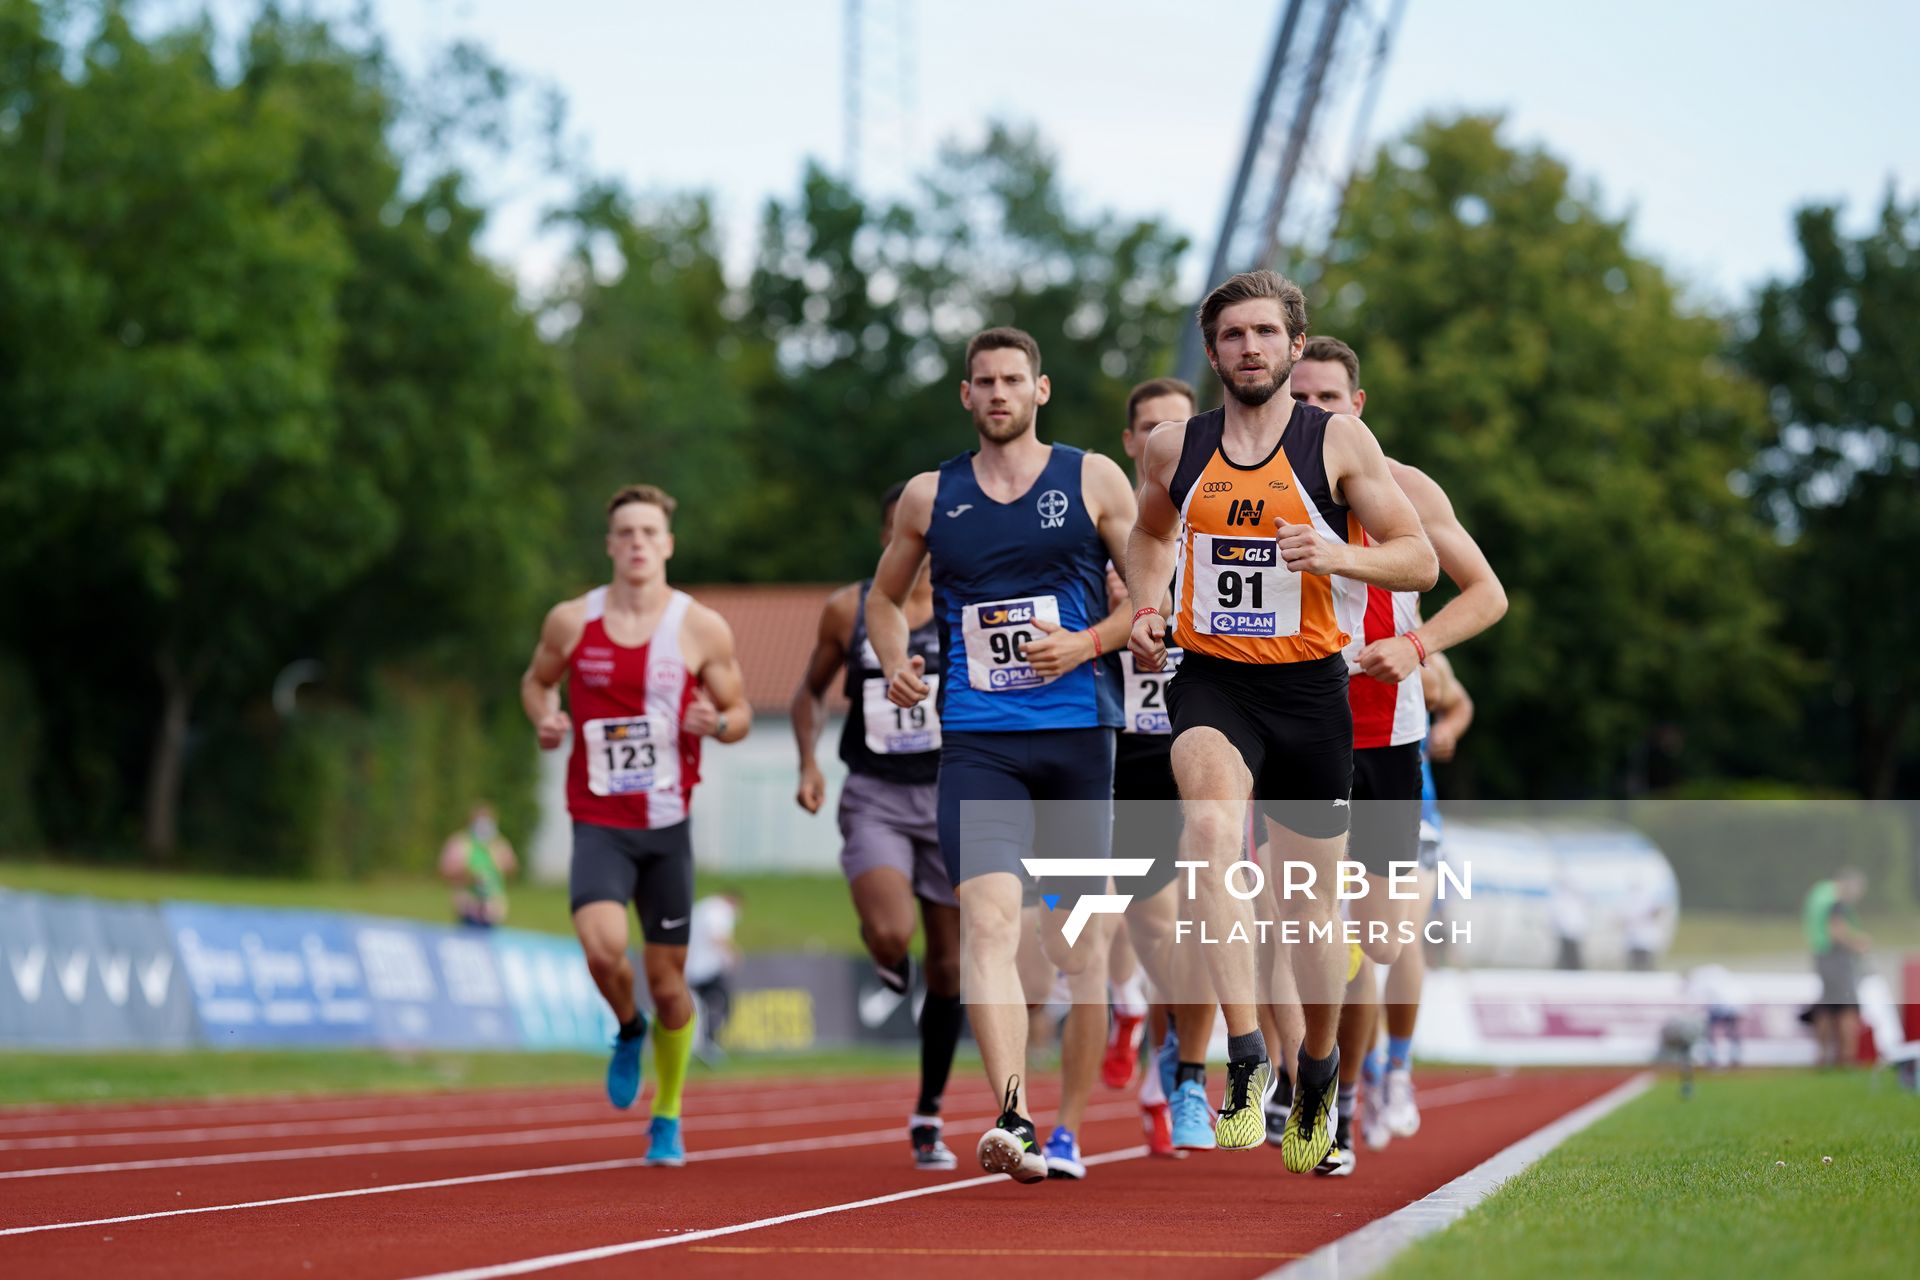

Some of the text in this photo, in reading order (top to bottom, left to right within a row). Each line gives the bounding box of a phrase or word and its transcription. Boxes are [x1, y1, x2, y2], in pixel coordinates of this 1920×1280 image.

[1041, 517, 1065, 529] LAV
[1245, 548, 1271, 562] GLS
[1217, 571, 1263, 609] 91
[1008, 607, 1031, 622] GLS
[1237, 616, 1273, 628] PLAN
[892, 705, 926, 730] 19
[605, 743, 656, 771] 123
